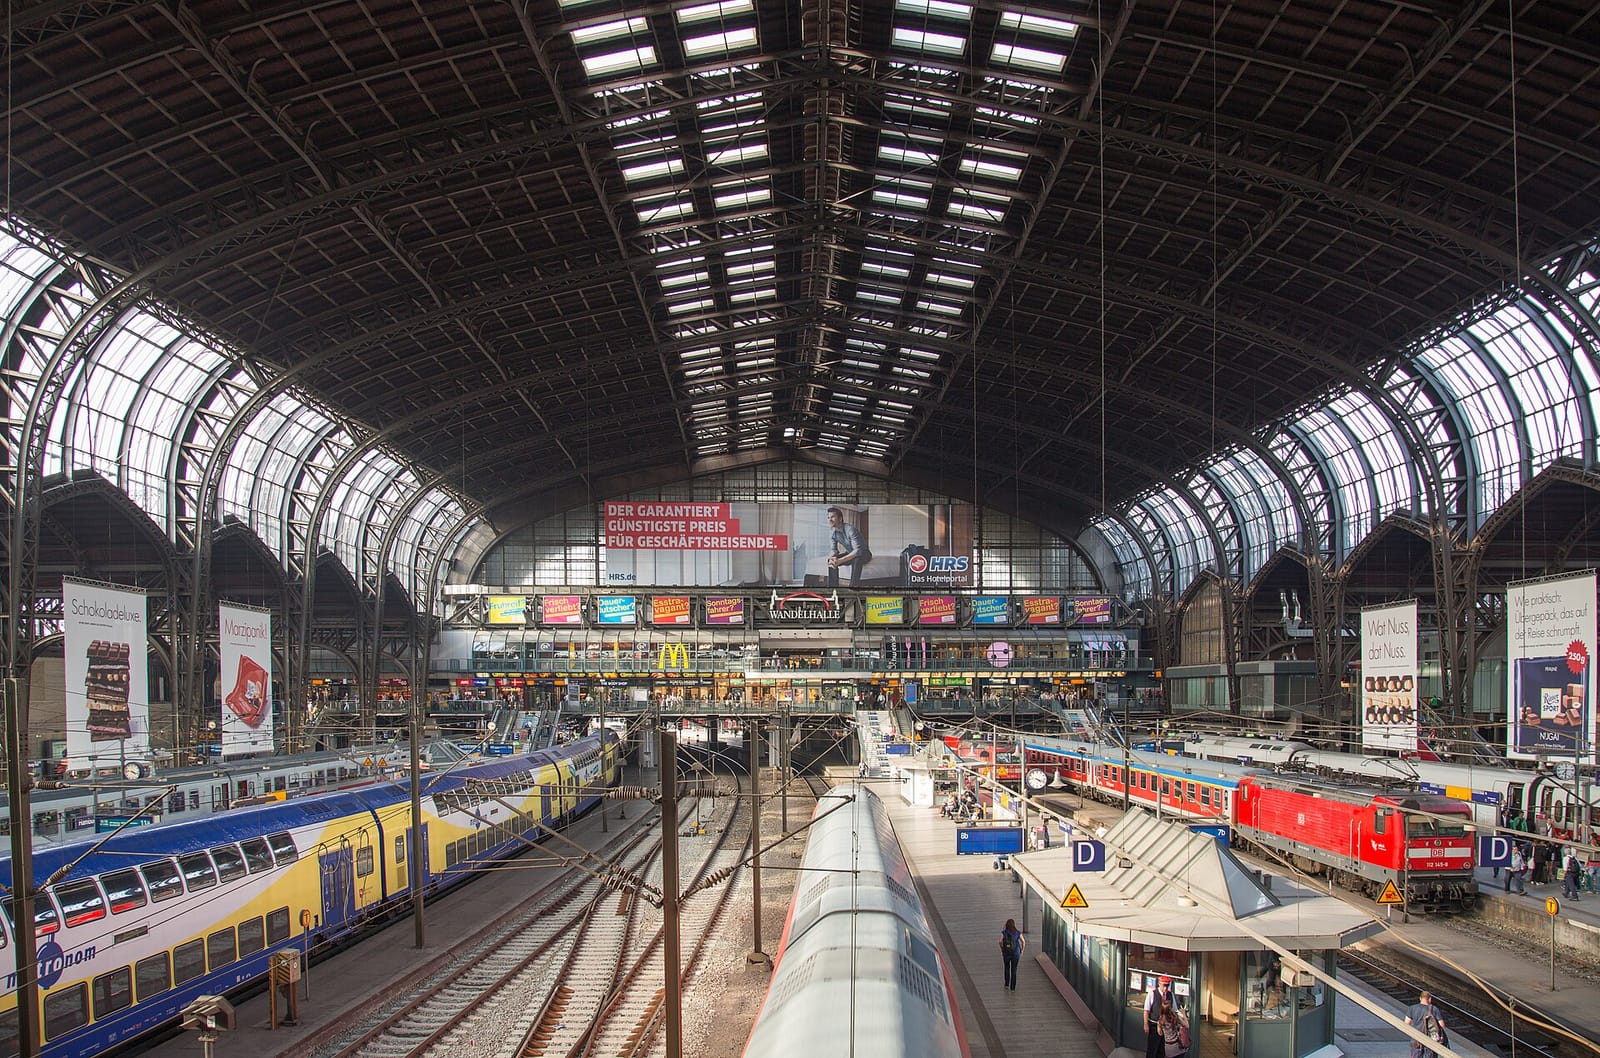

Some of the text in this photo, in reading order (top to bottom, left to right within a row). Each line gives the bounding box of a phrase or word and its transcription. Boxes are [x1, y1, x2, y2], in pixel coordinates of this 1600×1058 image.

[608, 505, 720, 517] DER GARANTIERT
[608, 518, 726, 533] GÜNSTIGSTE PREIS
[608, 534, 777, 548] FÜR GESCHÄFTSREISENDE.
[929, 556, 968, 572] HRS
[609, 573, 637, 581] HRS.de
[927, 575, 967, 584] Hotelportal
[545, 598, 568, 607] Frisch
[599, 598, 625, 607] Dauer-
[654, 598, 684, 608] Esstra-
[706, 598, 743, 607] Sonntags-
[920, 598, 944, 607] Frisch
[972, 598, 997, 607] Dauer-
[1024, 598, 1054, 607] Esstra-
[1075, 598, 1110, 607] Sonntags-
[72, 598, 141, 622] Schokoladeluxe.
[545, 603, 580, 613] verliebt?
[654, 602, 689, 614] vagant?
[707, 604, 734, 614] fahrer?
[920, 603, 956, 614] verliebt?
[1560, 607, 1573, 619] das
[1575, 603, 1588, 617] auf
[770, 610, 840, 619] WANDELHALLE
[1368, 617, 1410, 637] Wat Nuss,
[1528, 628, 1545, 639] Reise
[1546, 622, 1581, 639] schrumpft.
[1369, 641, 1406, 660] dat Nuss.
[1078, 842, 1095, 865] D
[1491, 837, 1508, 860] D
[326, 902, 329, 912] 2
[6, 946, 96, 989] mtronom
